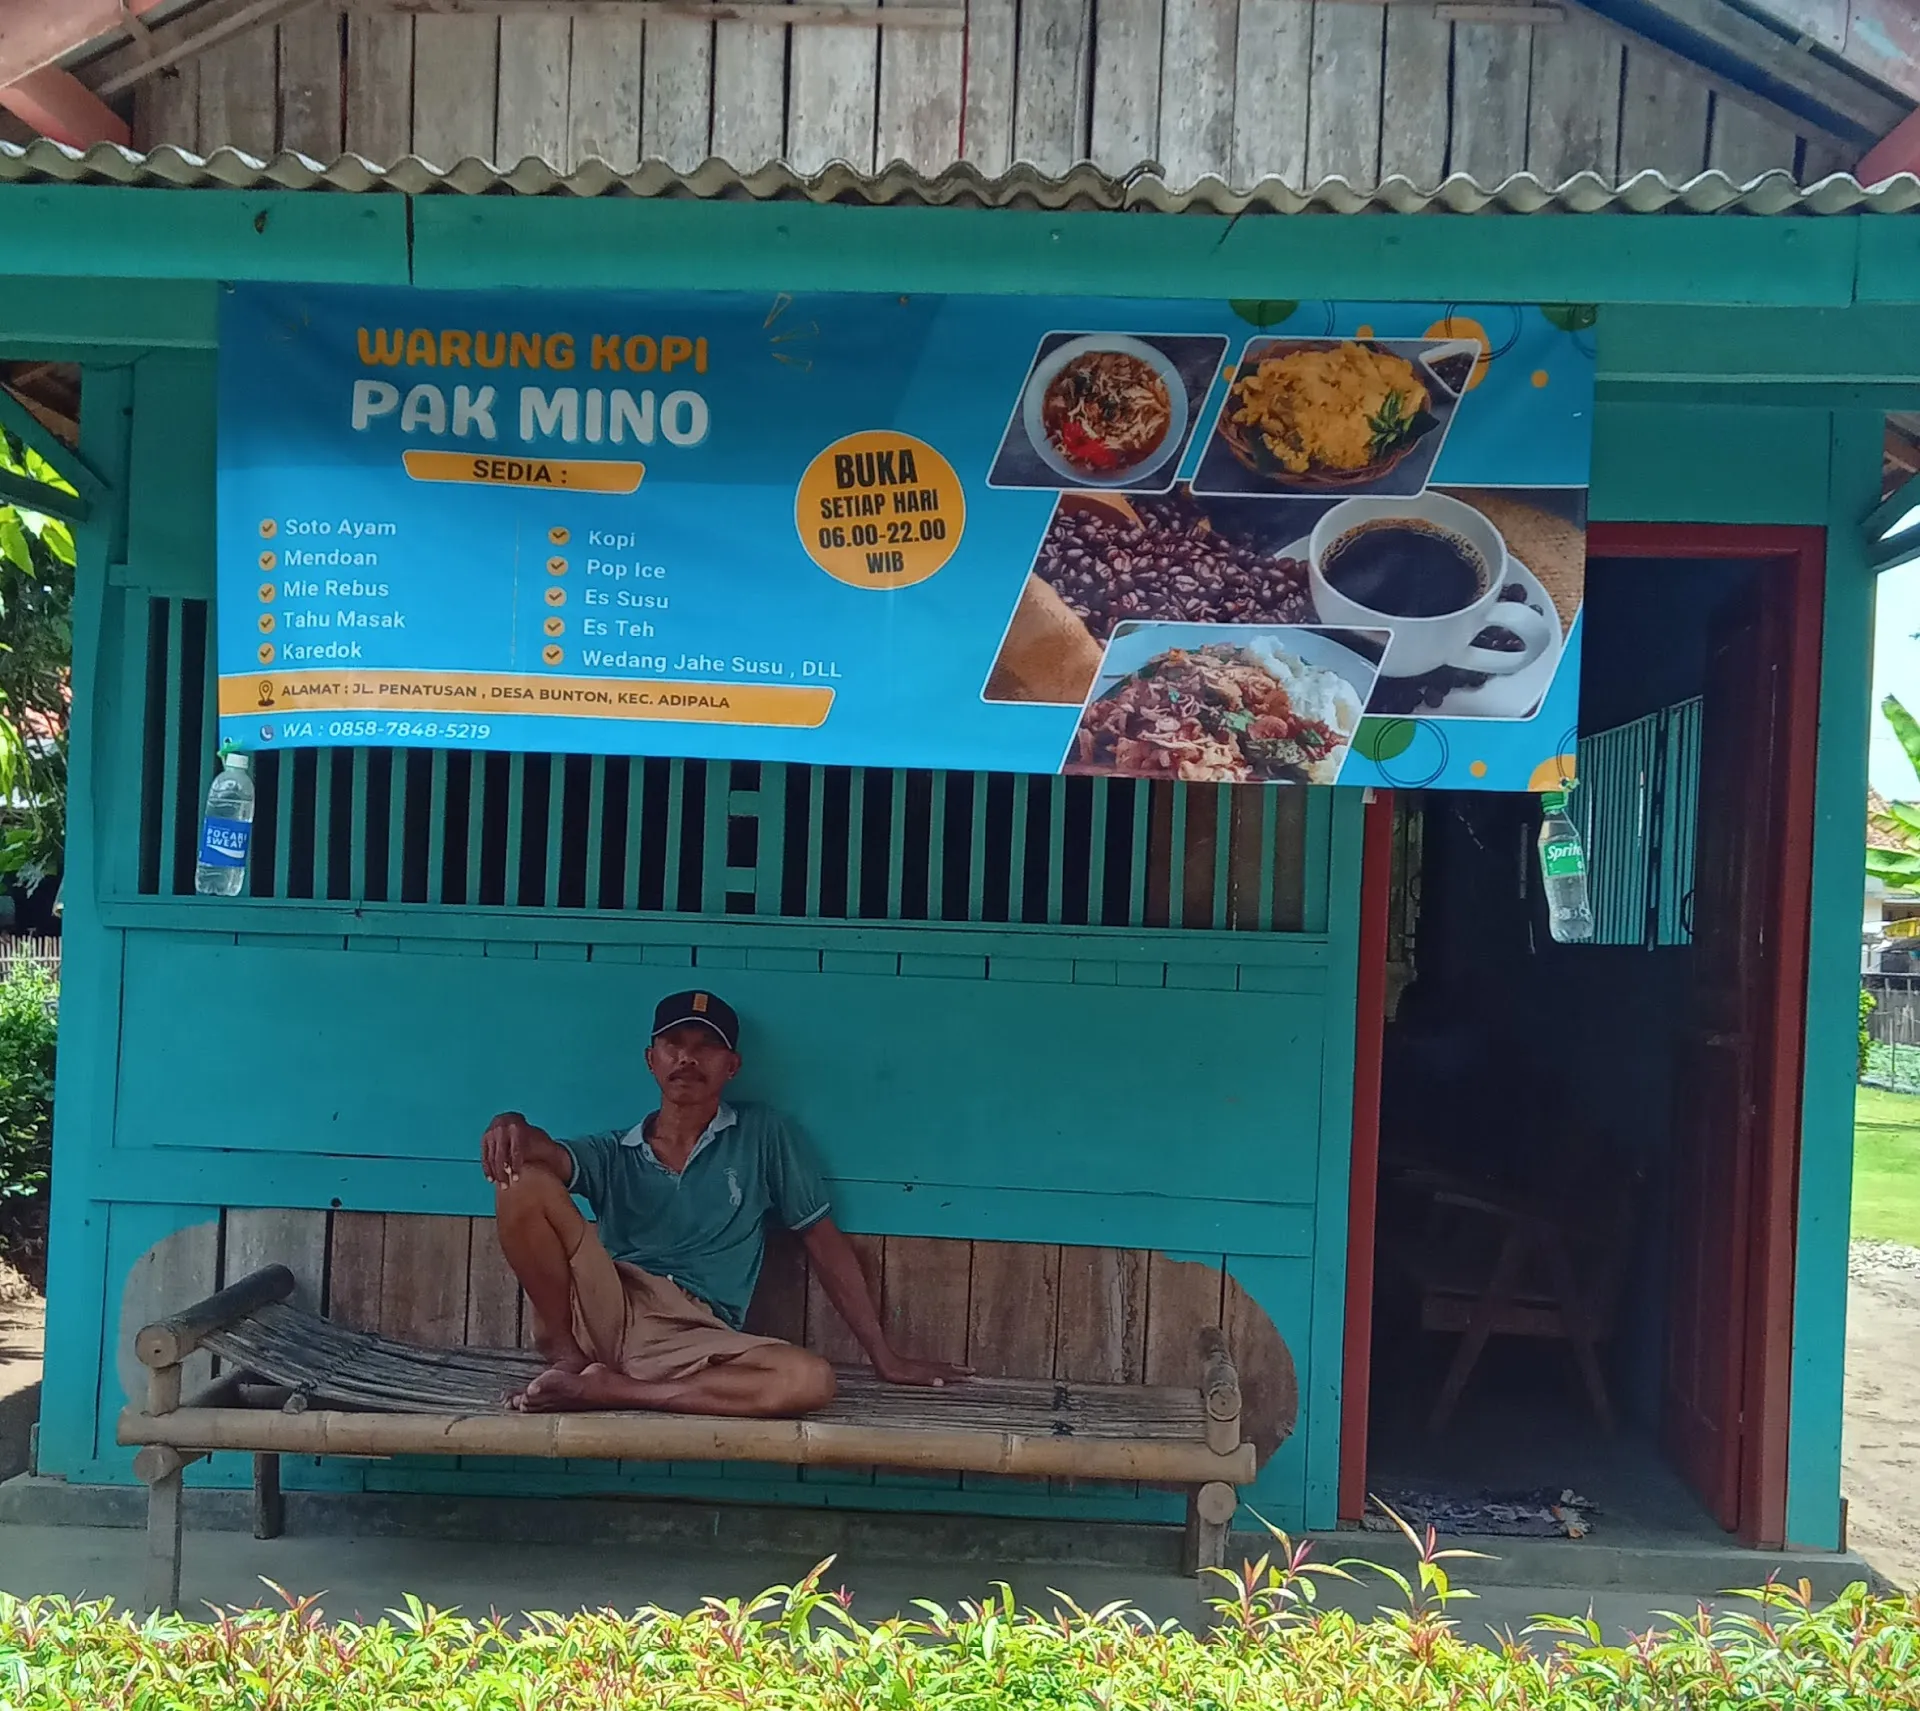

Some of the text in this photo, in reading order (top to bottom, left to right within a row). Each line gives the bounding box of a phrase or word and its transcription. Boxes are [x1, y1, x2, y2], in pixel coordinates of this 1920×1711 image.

[357, 326, 708, 374] WARUNG KOPI
[351, 379, 710, 446] PAK MINO
[473, 459, 552, 484] SEDIA
[835, 449, 918, 489] BUKA
[820, 489, 939, 519] SETIAP HARI
[285, 518, 397, 538] Soto Ayam
[818, 518, 946, 549] 06.00-22.00
[588, 530, 635, 550] Kopi
[284, 549, 377, 566] Mendoan
[866, 550, 905, 574] WIB
[587, 558, 666, 580] Pop Ice
[283, 580, 389, 597] Mie Rebus
[585, 589, 669, 609] Es Susu
[283, 610, 406, 628] Tahu Masak
[583, 618, 654, 638] Es Teh
[283, 641, 362, 660] Karedok
[582, 650, 667, 673] Wedang
[674, 654, 725, 672] Jahe
[731, 657, 783, 675] Susu
[802, 661, 842, 678] DLL
[281, 683, 341, 697] ALAMAT
[352, 683, 374, 695] JL.
[379, 683, 477, 698] PENATUSAN
[491, 687, 534, 699] DESA
[539, 689, 613, 705] BUNTON,
[618, 693, 654, 705] KEC.
[657, 694, 730, 709] ADIPALA
[282, 723, 314, 738] WA
[329, 721, 491, 740] 0858-7848-5219
[206, 836, 243, 848] SWEAT
[207, 828, 247, 843] POCARI
